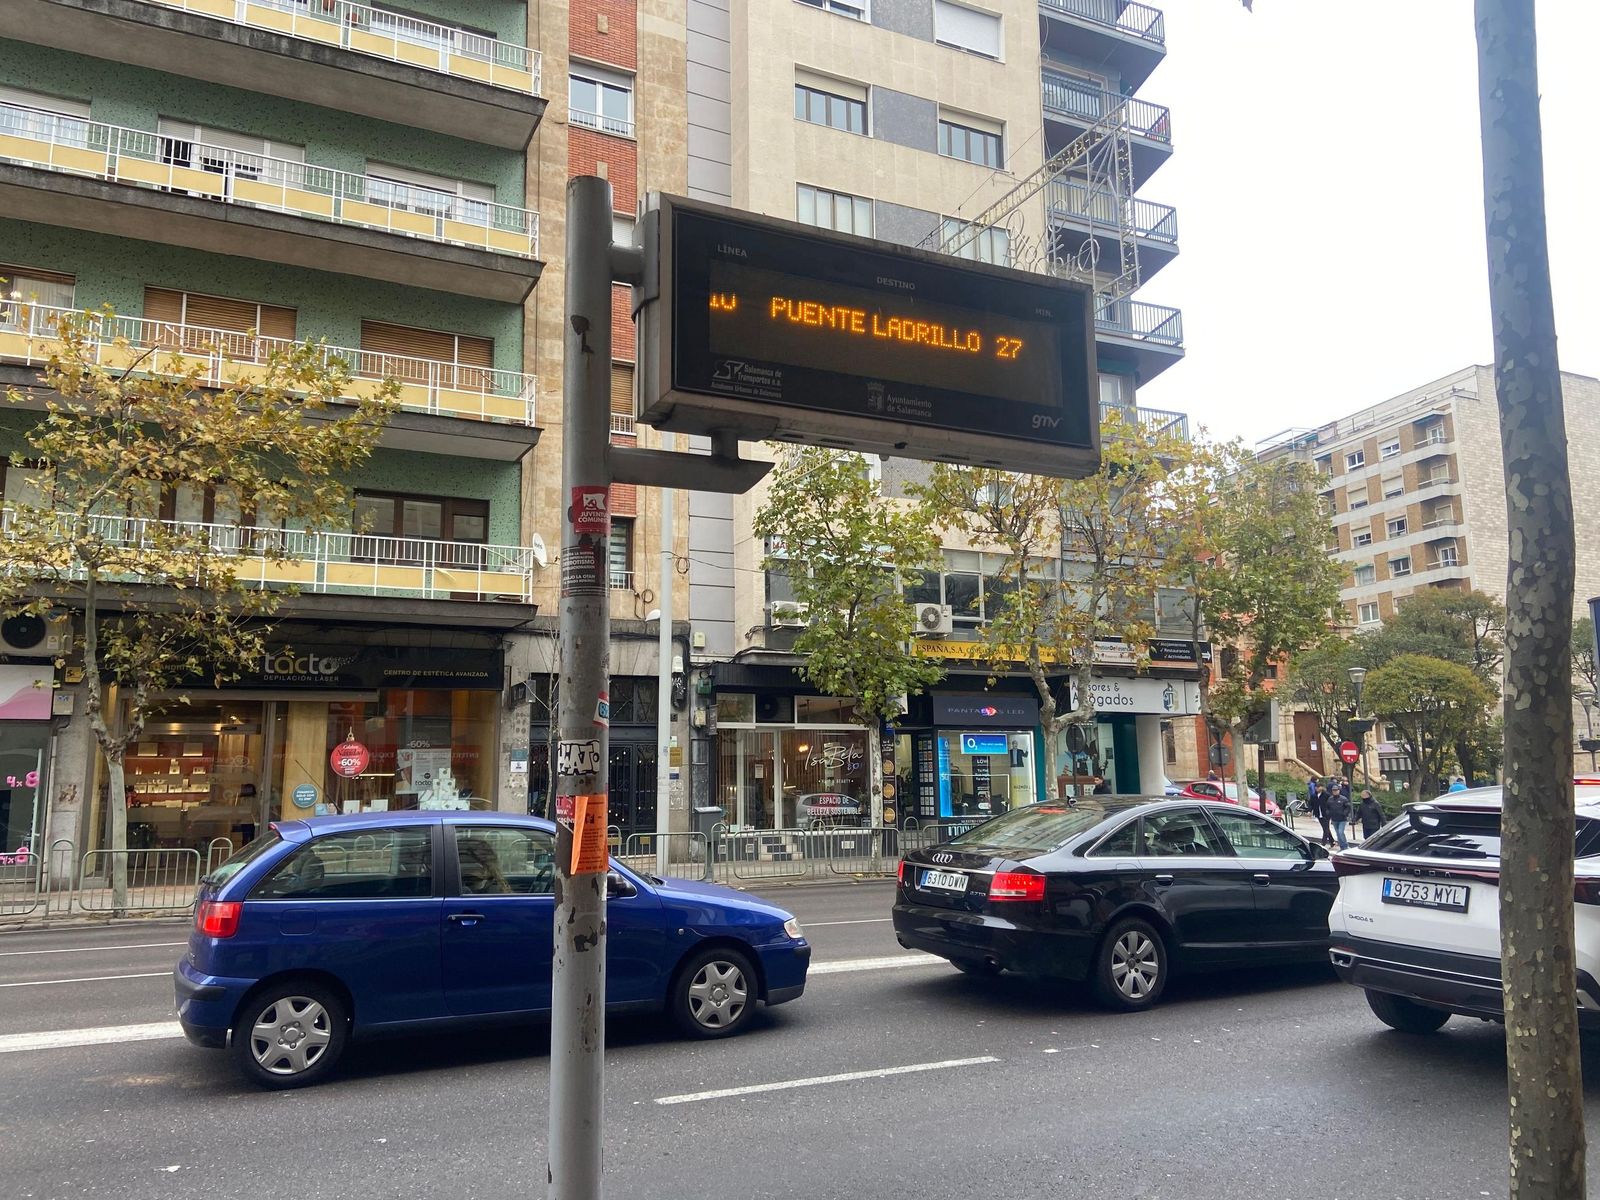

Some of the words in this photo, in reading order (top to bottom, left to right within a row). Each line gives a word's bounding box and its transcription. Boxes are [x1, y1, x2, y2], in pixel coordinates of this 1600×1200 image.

[876, 276, 916, 291] DESTINO
[770, 296, 866, 333] PUENTE
[873, 314, 981, 353] LADRILLO
[995, 336, 1023, 359] 27
[738, 371, 771, 385] Transportes
[744, 364, 774, 377] Salamanca
[775, 369, 782, 378] de
[887, 393, 932, 409] Ayuntamiento
[897, 405, 932, 417] Salamanca
[1032, 413, 1063, 429] gmv
[264, 652, 340, 676] tacto
[263, 674, 312, 682] DEPILACIÓN
[423, 669, 454, 677] ESTÉTICA
[1071, 681, 1111, 692] Asores
[1114, 682, 1120, 692] &
[1073, 692, 1134, 706] Aogados
[819, 796, 841, 805] ESPACIO
[807, 807, 830, 816] BELLEZA
[831, 806, 862, 815] SOSTENIBLE
[927, 872, 948, 886] 6310
[948, 875, 966, 889] DWN
[1394, 883, 1429, 900] 9753
[1434, 886, 1462, 905] MYL
